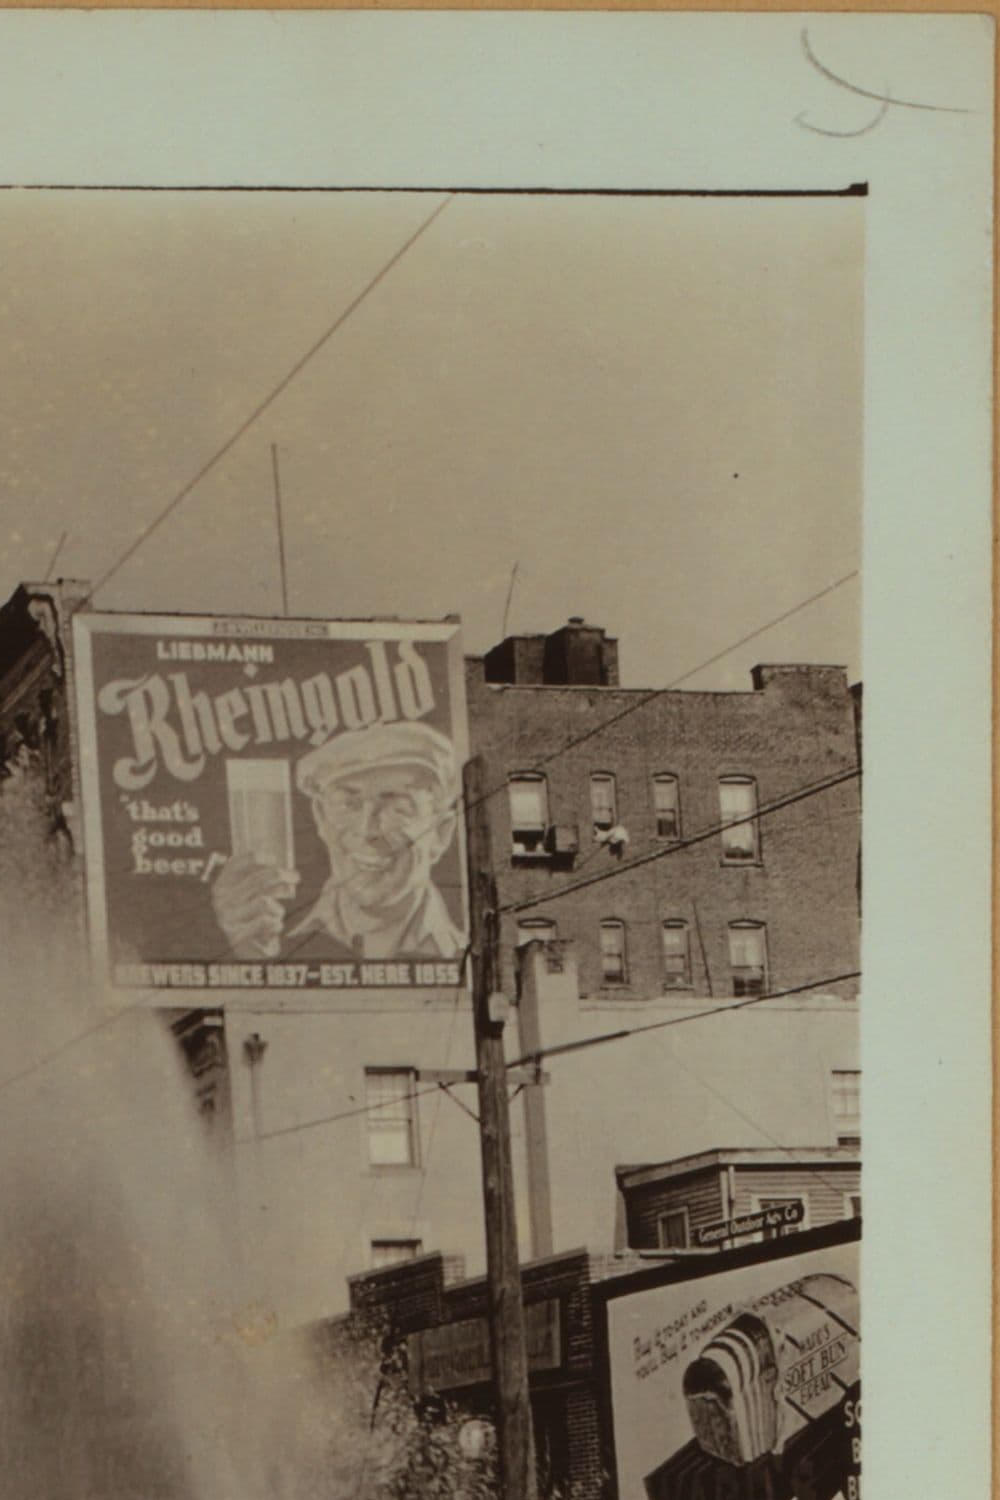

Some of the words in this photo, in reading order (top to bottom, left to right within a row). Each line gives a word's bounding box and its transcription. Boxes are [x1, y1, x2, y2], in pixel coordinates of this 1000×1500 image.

[156, 640, 275, 663] LIEBMANN
[98, 638, 436, 792] Rheingold
[131, 827, 204, 855] good
[208, 963, 264, 986] SINCE
[361, 963, 411, 985] HERE
[415, 962, 460, 984] 1855
[783, 1356, 815, 1393] SOFT
